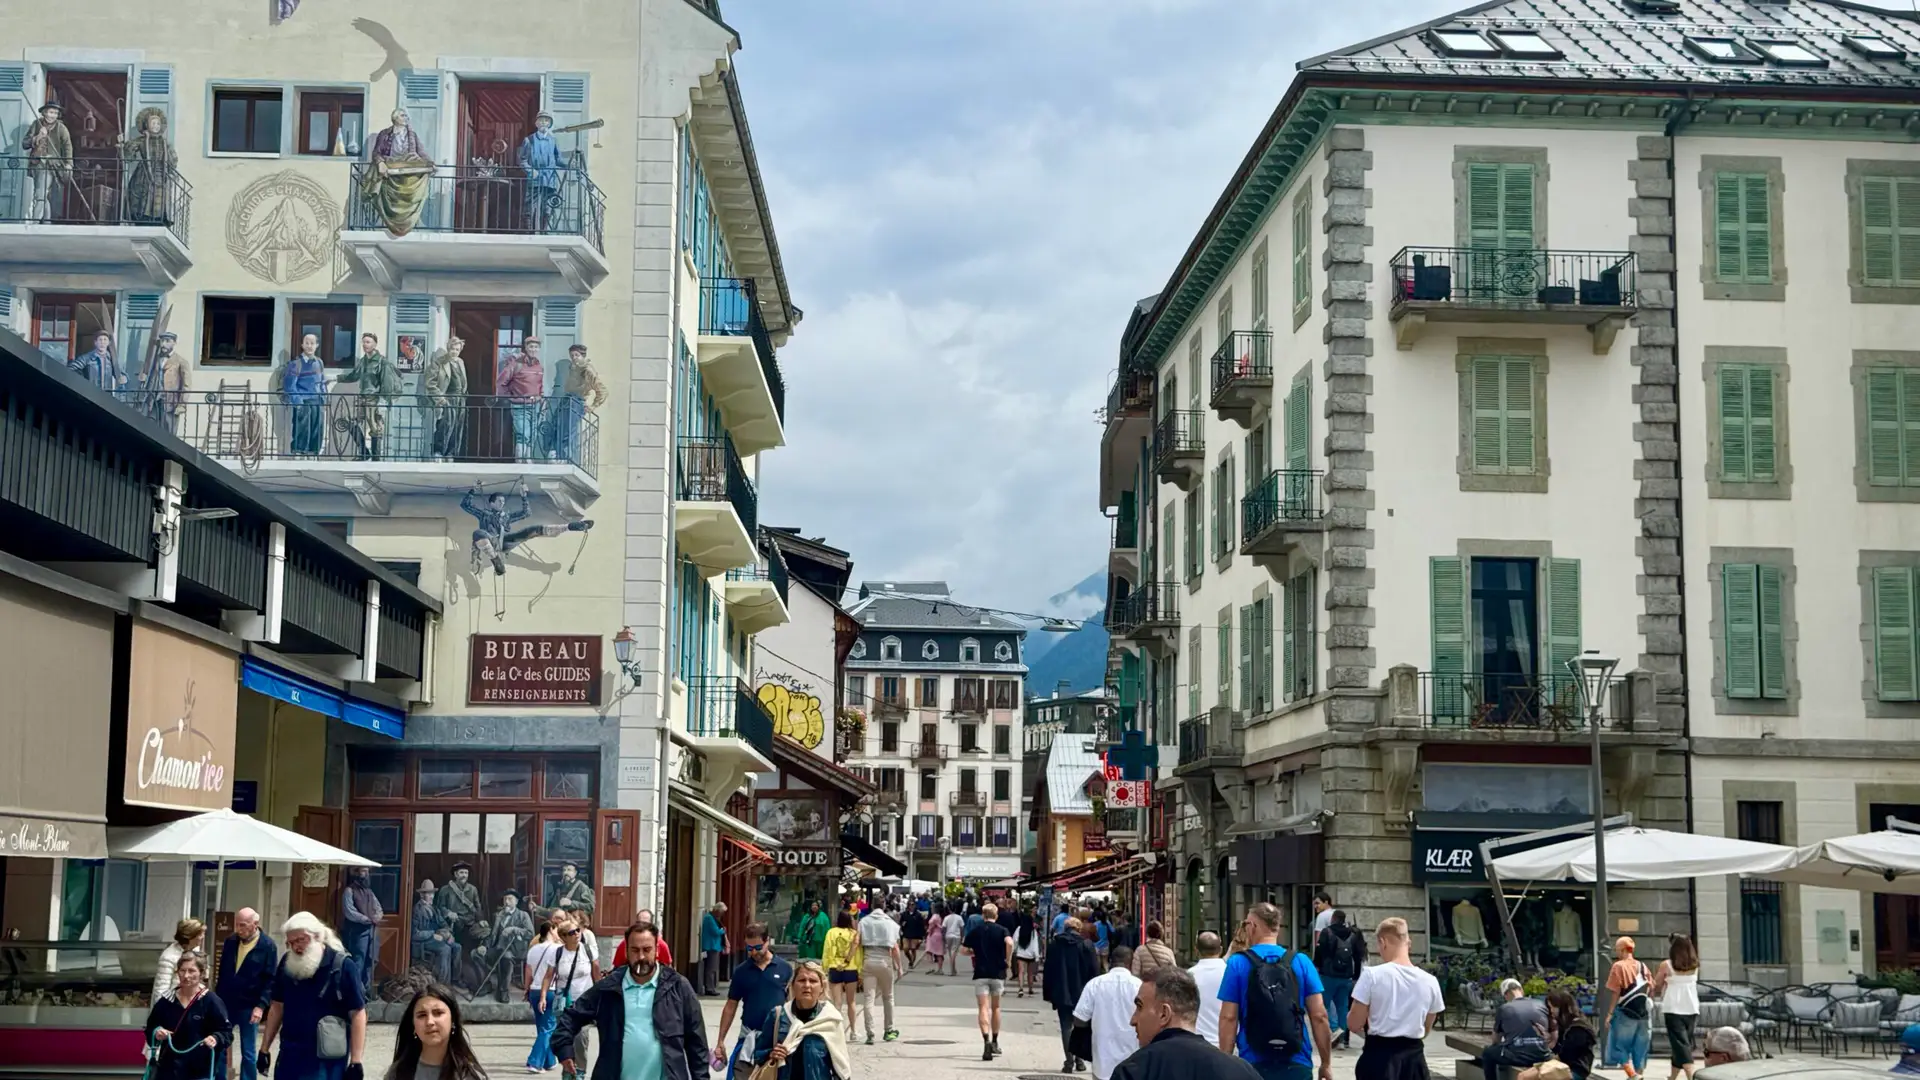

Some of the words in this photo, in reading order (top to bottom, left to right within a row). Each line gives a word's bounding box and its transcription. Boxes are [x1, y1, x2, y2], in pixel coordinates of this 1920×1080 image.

[240, 186, 274, 221] GUIDES
[275, 184, 328, 232] CHAMONIX
[484, 640, 588, 660] BUREAU
[481, 666, 494, 681] de
[497, 666, 506, 681] la
[524, 667, 541, 681] des
[544, 666, 591, 681] GUIDES
[484, 688, 586, 700] RENSEIGNEMENTS
[138, 727, 224, 792] Chamon'ice
[1111, 782, 1134, 793] POCO
[1111, 795, 1134, 806] LOCO
[11, 823, 70, 852] Mont-Blanc
[1425, 848, 1473, 867] KLÆR
